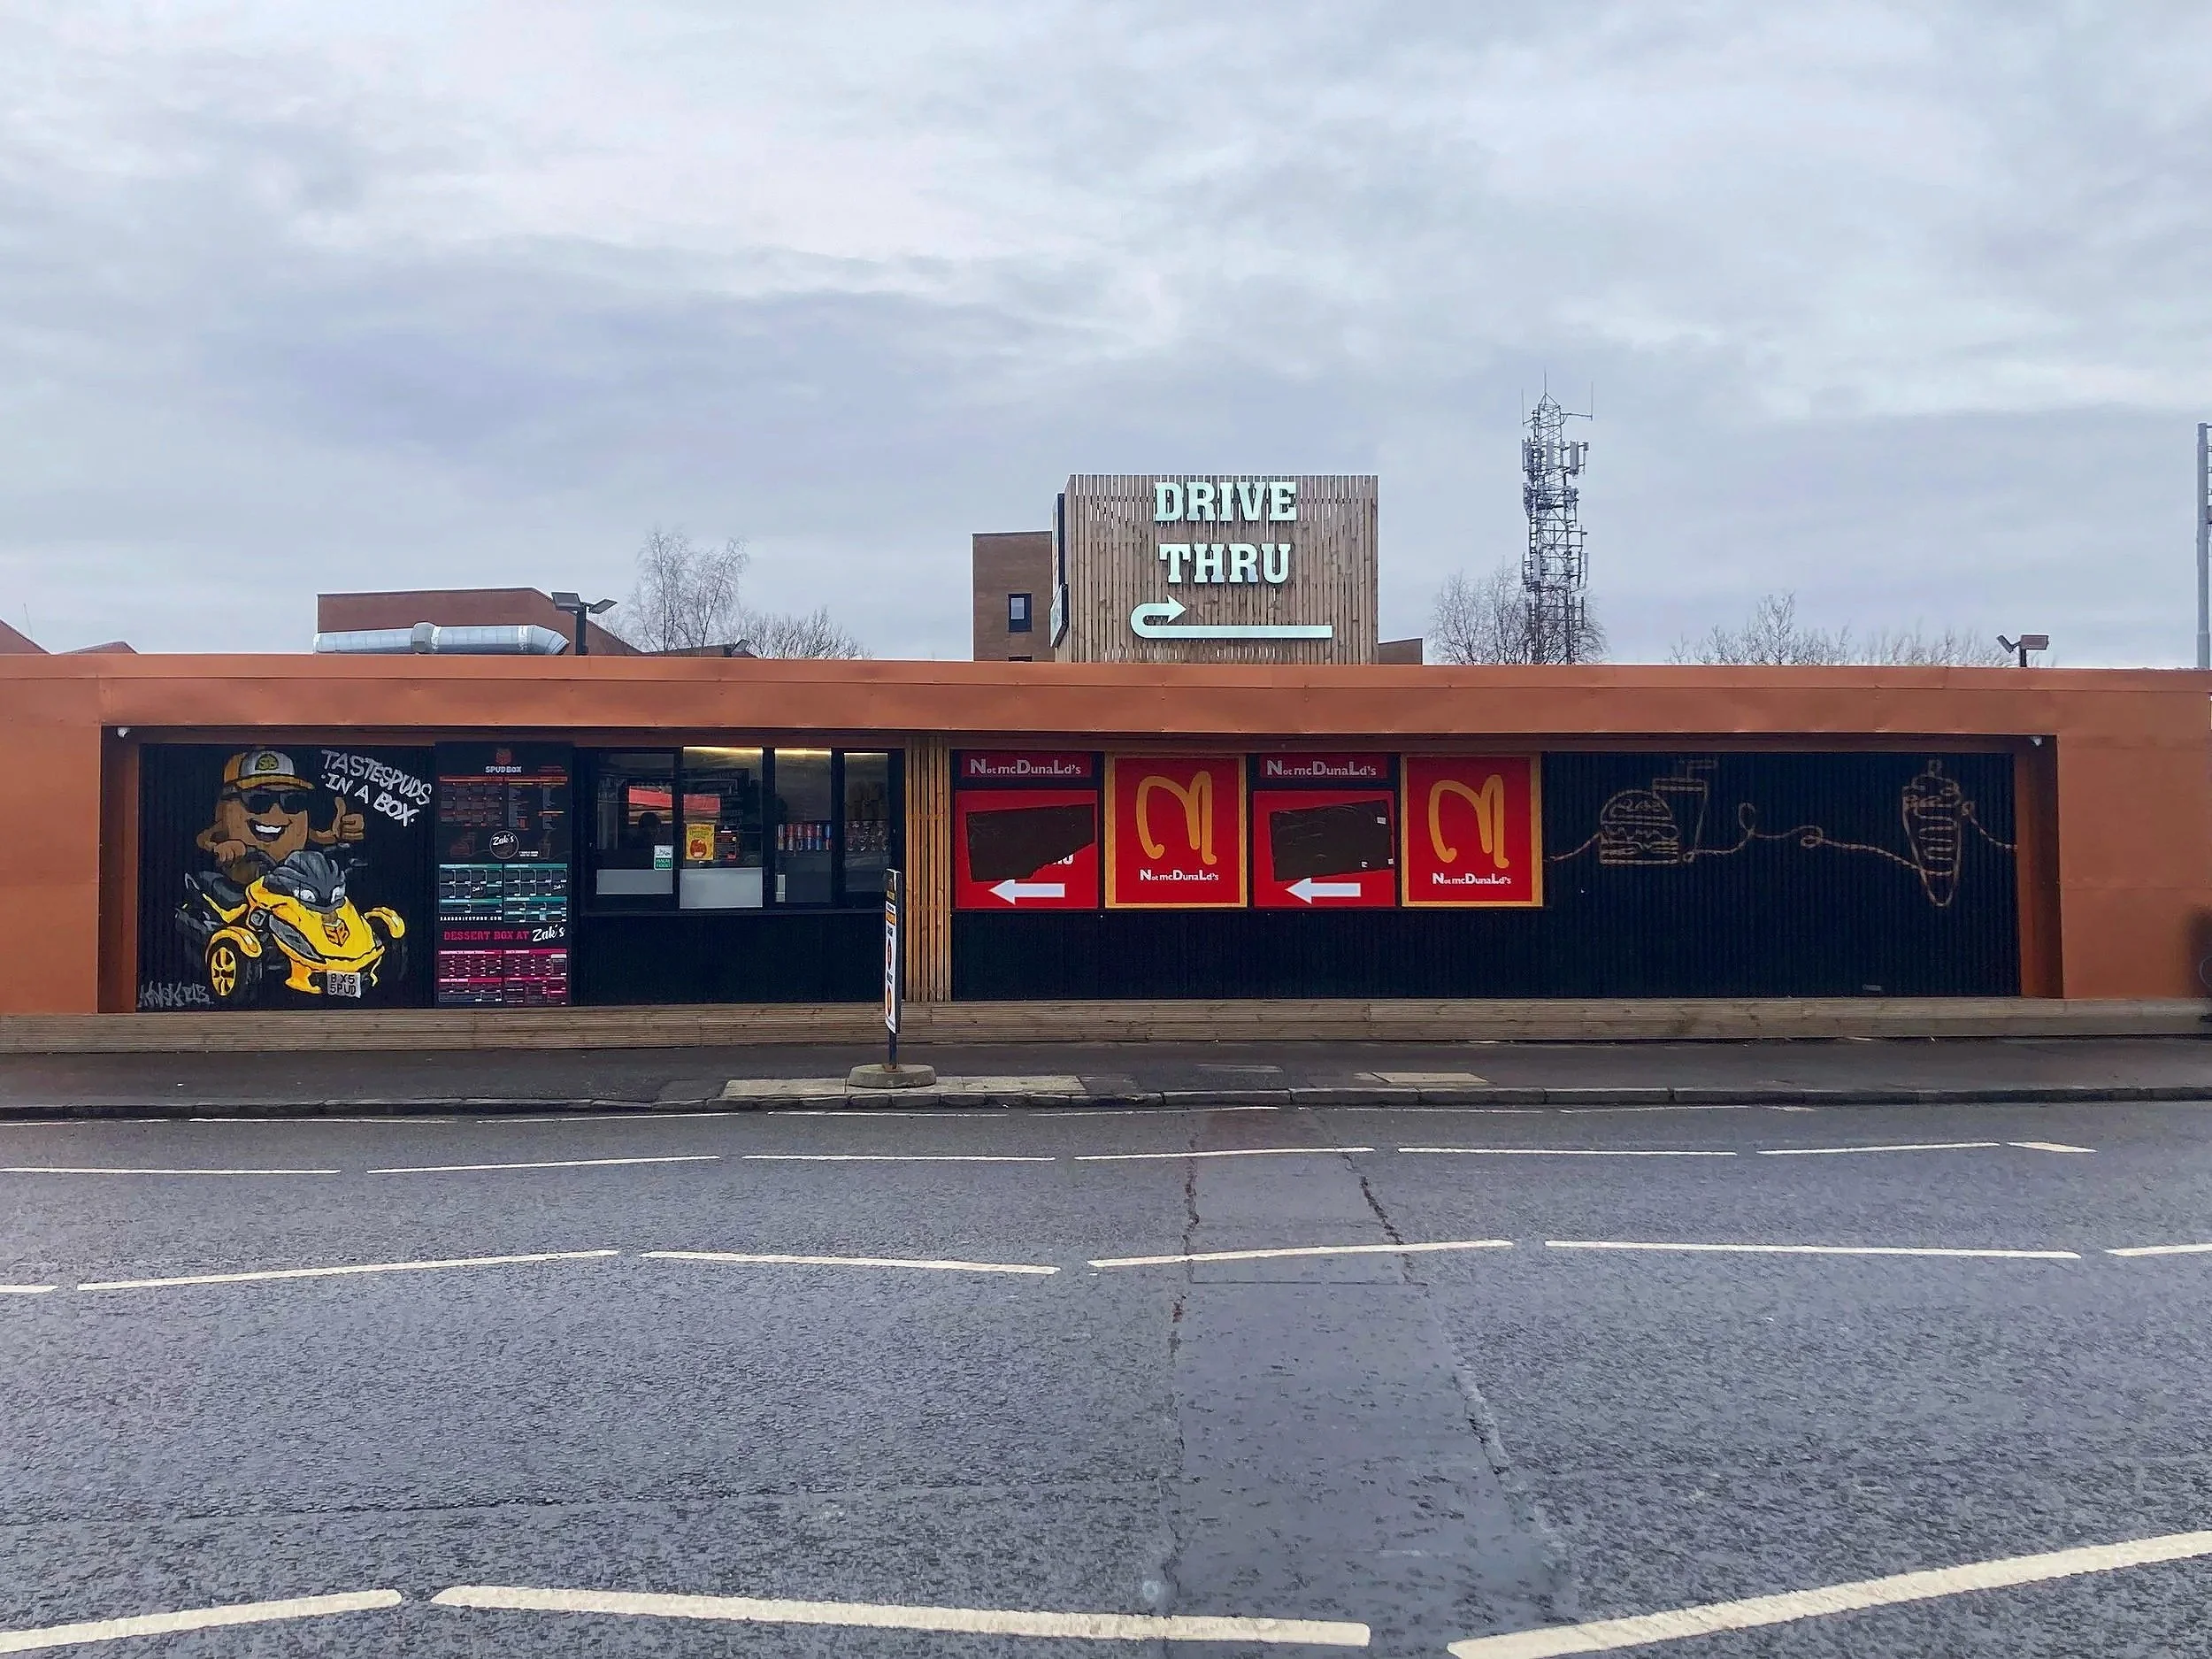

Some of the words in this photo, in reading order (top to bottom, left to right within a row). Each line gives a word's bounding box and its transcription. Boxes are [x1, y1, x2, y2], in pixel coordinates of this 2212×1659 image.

[1154, 480, 1298, 522] DRIVE
[1158, 542, 1292, 585] THRU
[321, 749, 433, 806] TASTESPUDS
[354, 784, 370, 804] A
[443, 930, 490, 941] DESSERT
[515, 930, 530, 941] AT
[532, 925, 566, 942] Zak's
